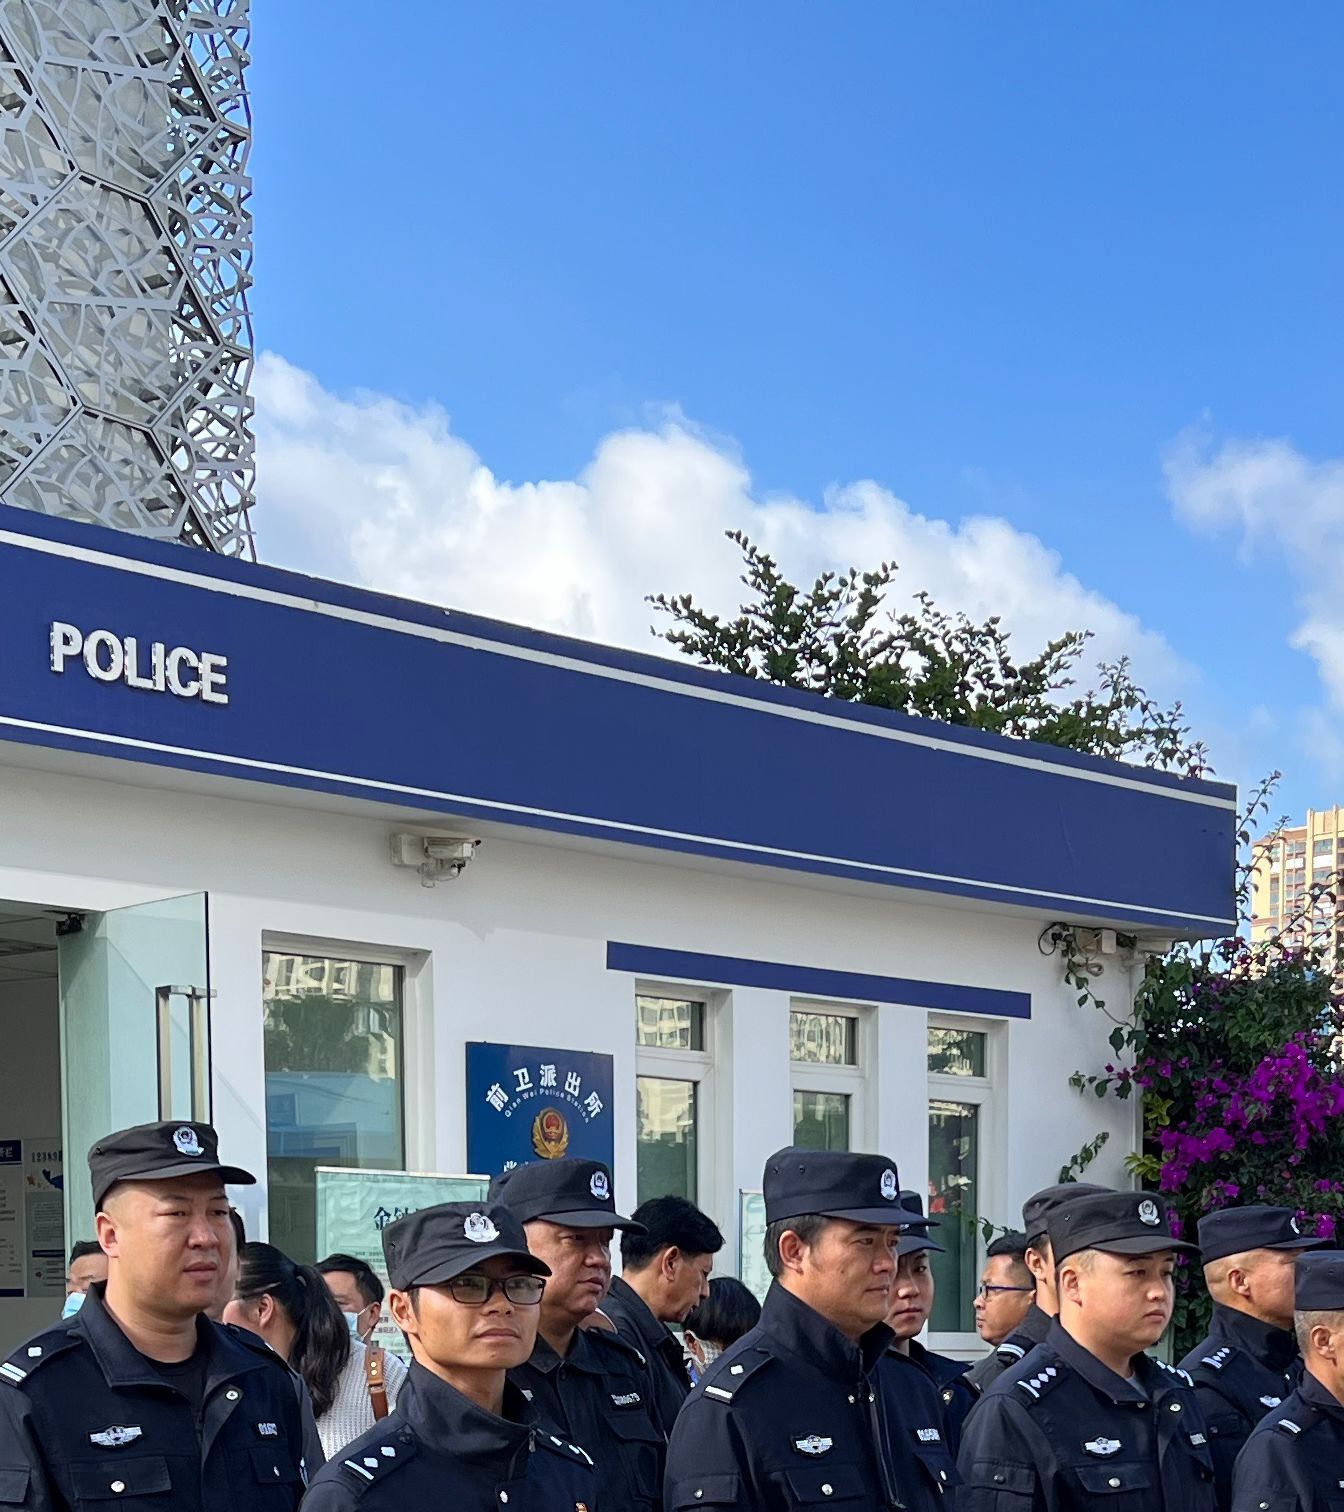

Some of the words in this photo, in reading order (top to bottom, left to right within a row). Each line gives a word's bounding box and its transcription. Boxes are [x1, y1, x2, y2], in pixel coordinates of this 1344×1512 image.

[50, 621, 229, 704] POLICE
[485, 1064, 604, 1118] 前卫派出所
[522, 1089, 538, 1100] Wei
[539, 1088, 565, 1099] Police
